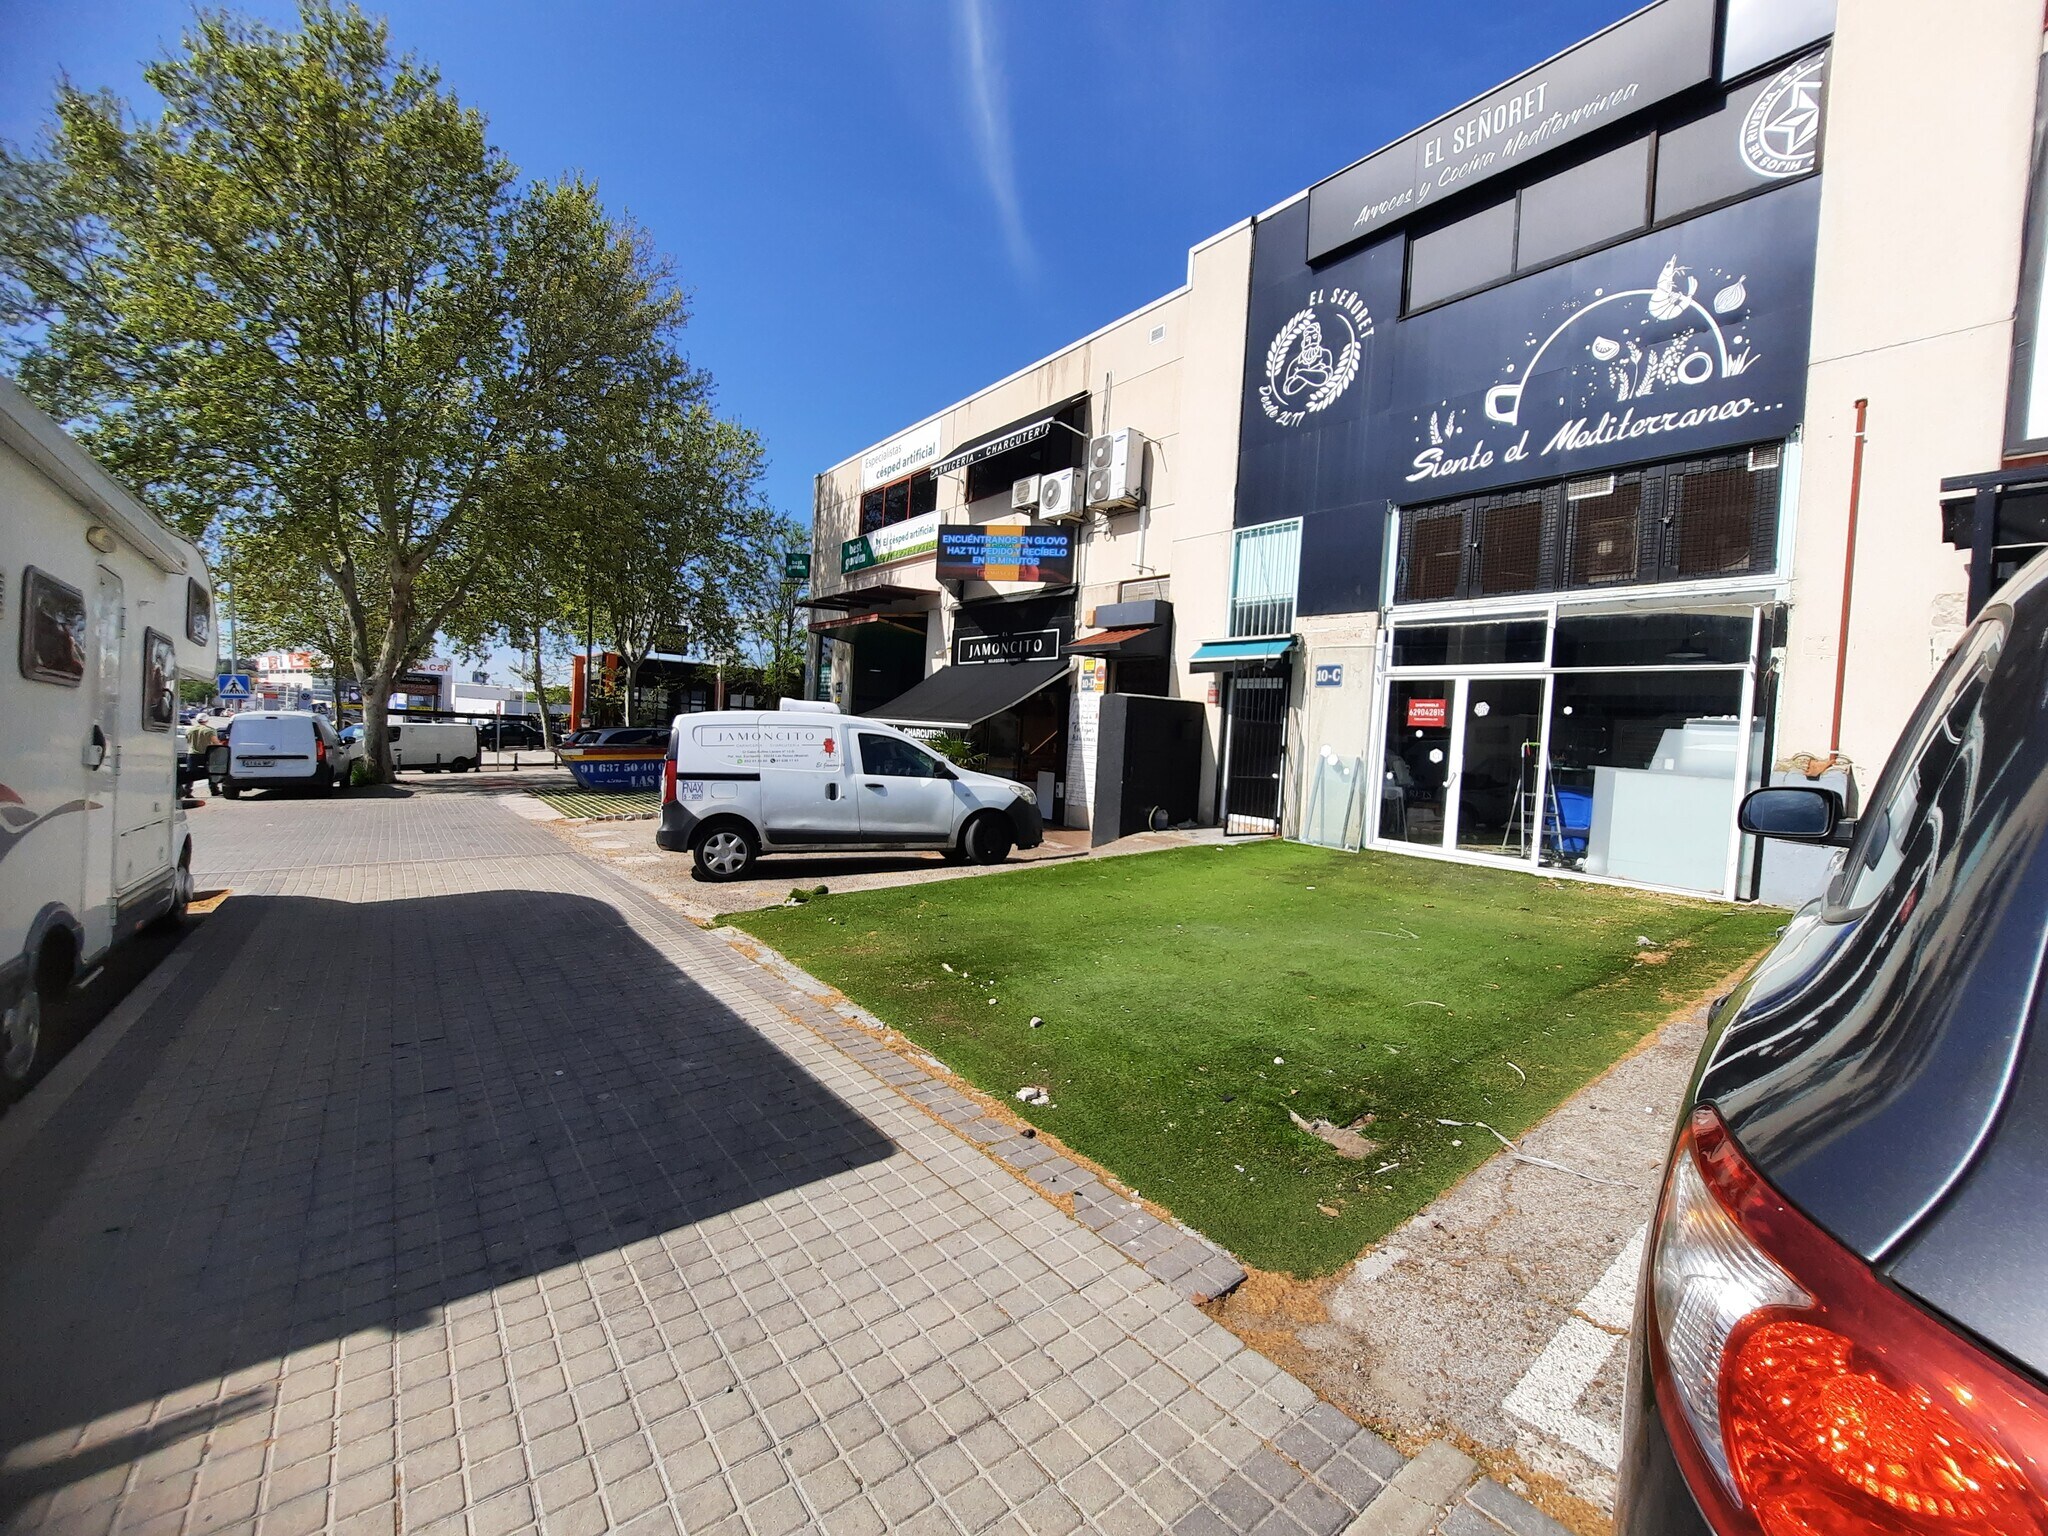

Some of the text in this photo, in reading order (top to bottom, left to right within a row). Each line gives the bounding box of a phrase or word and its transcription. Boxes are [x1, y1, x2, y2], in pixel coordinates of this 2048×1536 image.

[1424, 82, 1549, 169] EL SEÑORET
[1352, 82, 1640, 231] Arroces y Cocina Mediterránea
[1747, 142, 1762, 161] DE
[1759, 156, 1803, 171] HIJOS
[1309, 287, 1375, 339] EL SEÑORET
[1258, 385, 1306, 427] Desde 2017
[985, 422, 1050, 456] CHARCUTERÍA
[865, 443, 902, 469] Especialistas
[876, 442, 936, 479] césped artificial
[1405, 440, 1494, 483] Siente
[1504, 430, 1530, 462] el
[849, 540, 863, 553] best
[889, 532, 909, 547] césped
[942, 533, 1068, 545] ENCUÉNTRANOS EN GLOVO
[946, 546, 966, 555] HAZ
[967, 547, 980, 555] TU
[980, 547, 1014, 555] PEDIDO
[1022, 545, 1067, 556] RECÍBELO
[844, 554, 866, 571] garden
[972, 556, 1040, 565] EN 15 MINUTOS
[968, 638, 1043, 659] JAMONCITO
[1316, 669, 1341, 683] 10-C
[1408, 708, 1445, 717] 629042815
[718, 732, 815, 742] JAMONCITO
[580, 764, 594, 773] 91
[598, 763, 620, 773] 637
[623, 763, 638, 772] 50
[640, 762, 655, 771] 40
[630, 775, 655, 788] LAS
